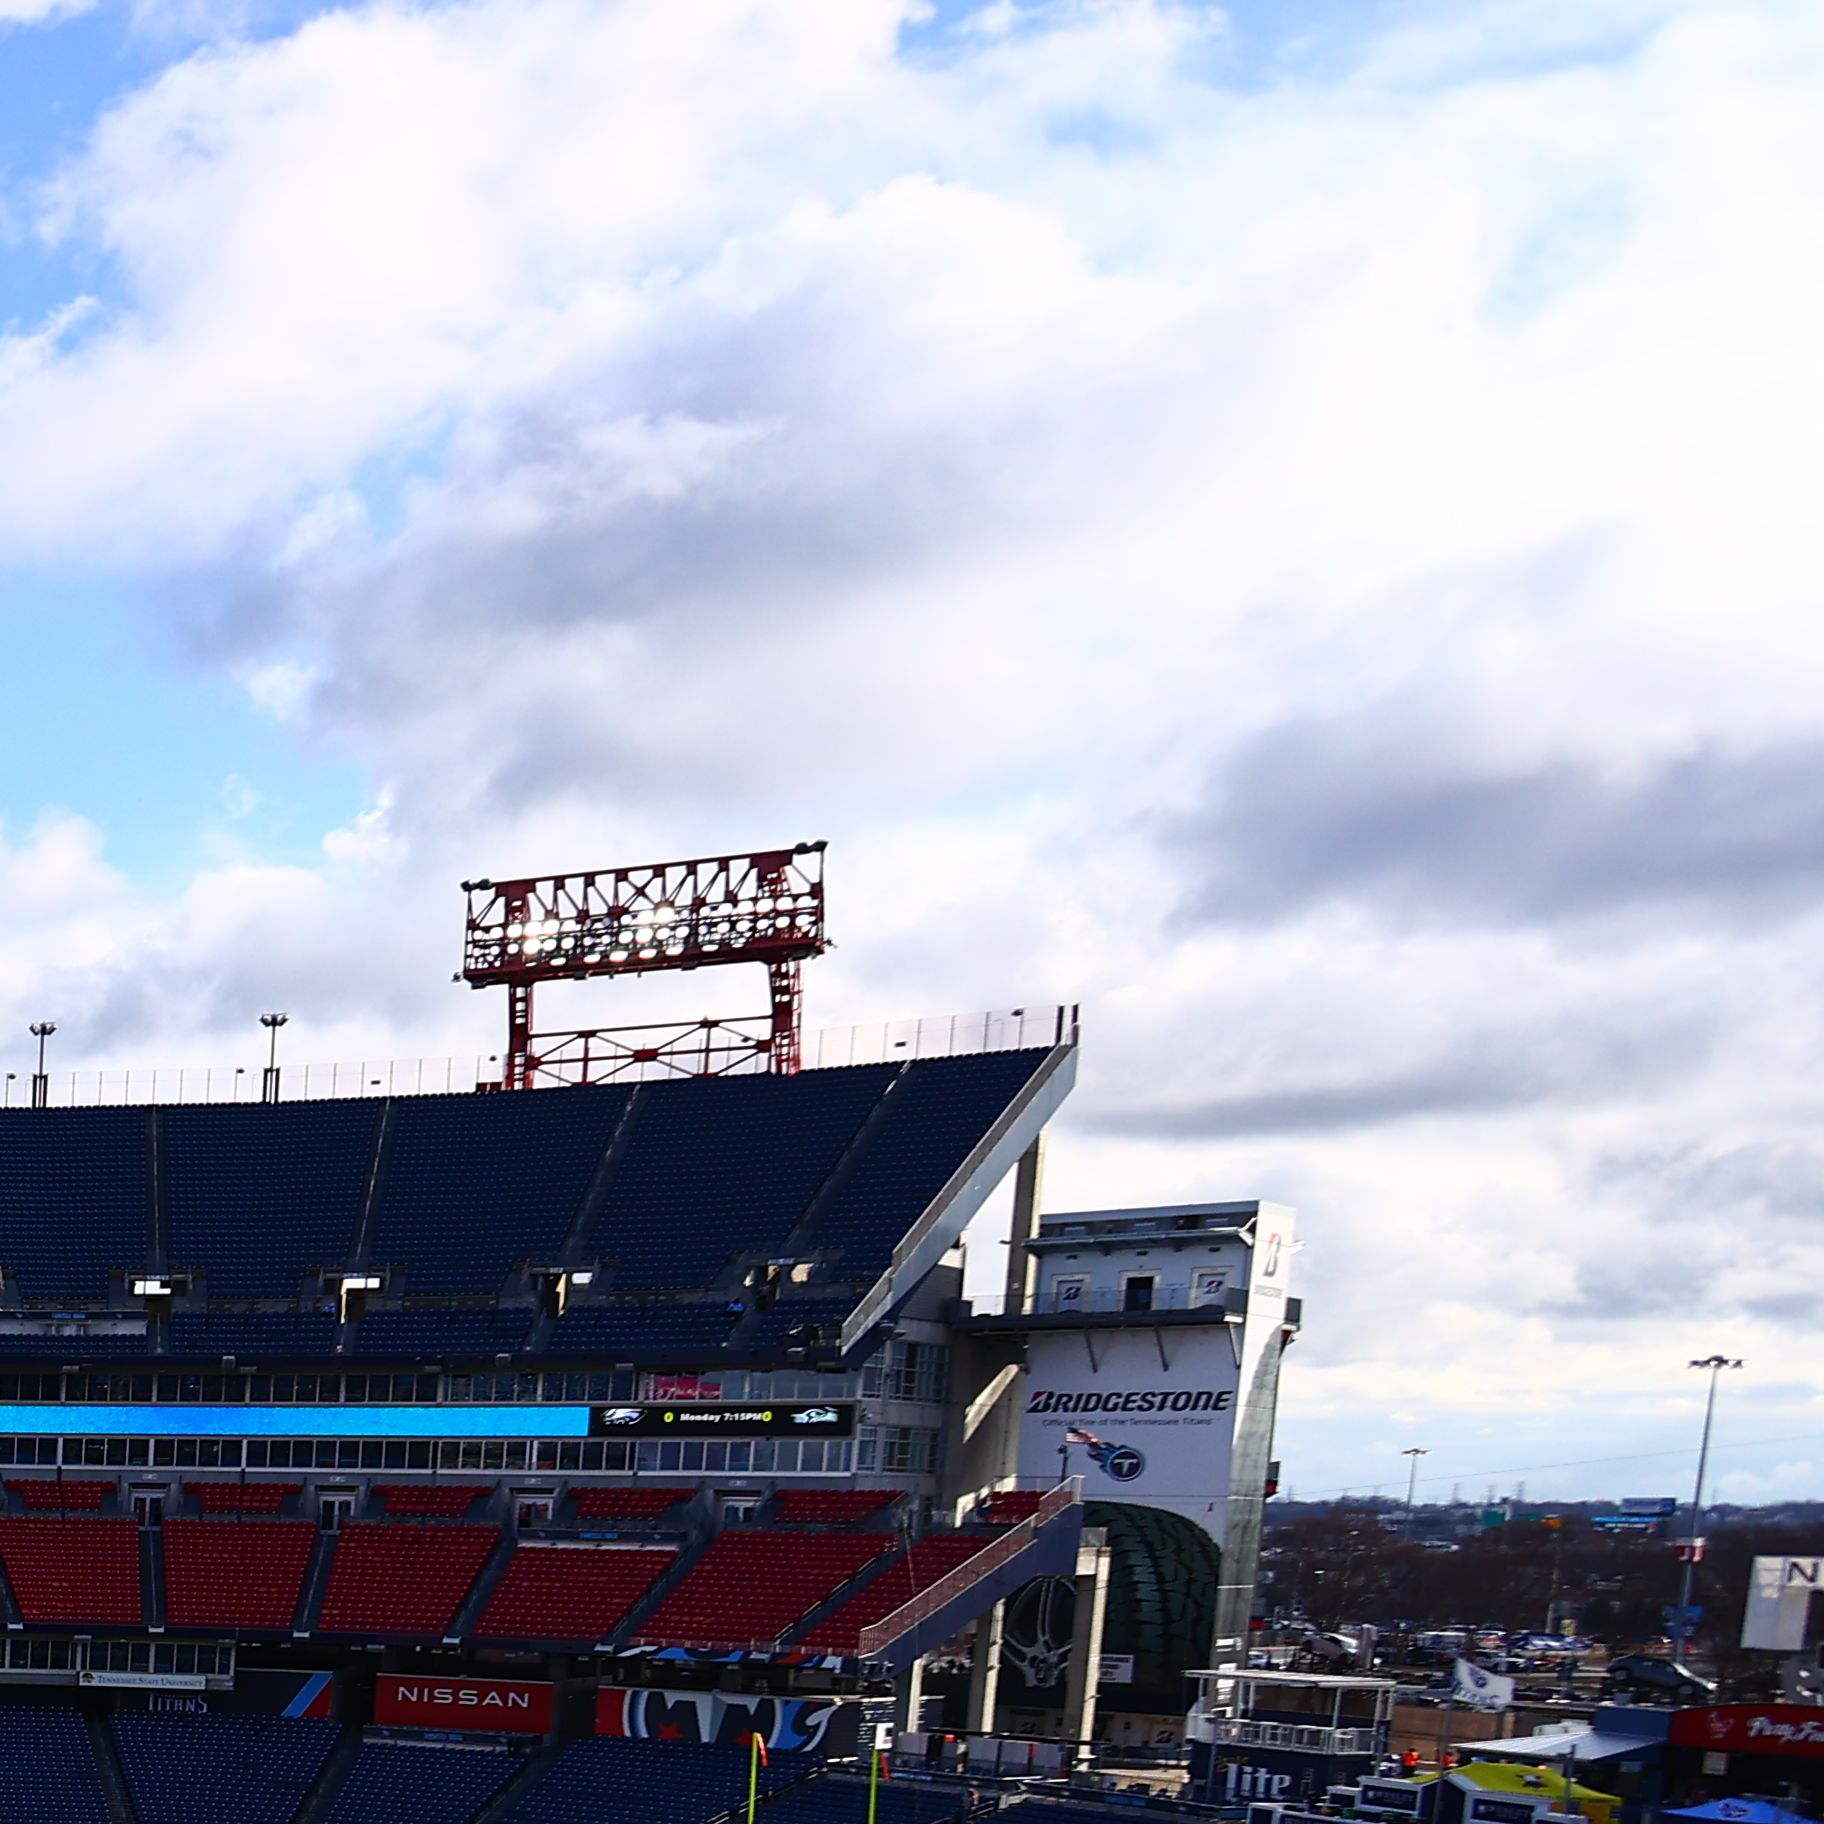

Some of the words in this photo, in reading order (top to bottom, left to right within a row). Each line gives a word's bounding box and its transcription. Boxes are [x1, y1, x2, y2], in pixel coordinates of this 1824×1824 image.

[1026, 1390, 1234, 1414] BRIDGESTONE
[664, 1412, 674, 1423] 0
[680, 1412, 722, 1422] Monday
[723, 1412, 762, 1421] 7:15PM
[144, 1691, 209, 1713] TITANS
[397, 1686, 529, 1708] NISSAN
